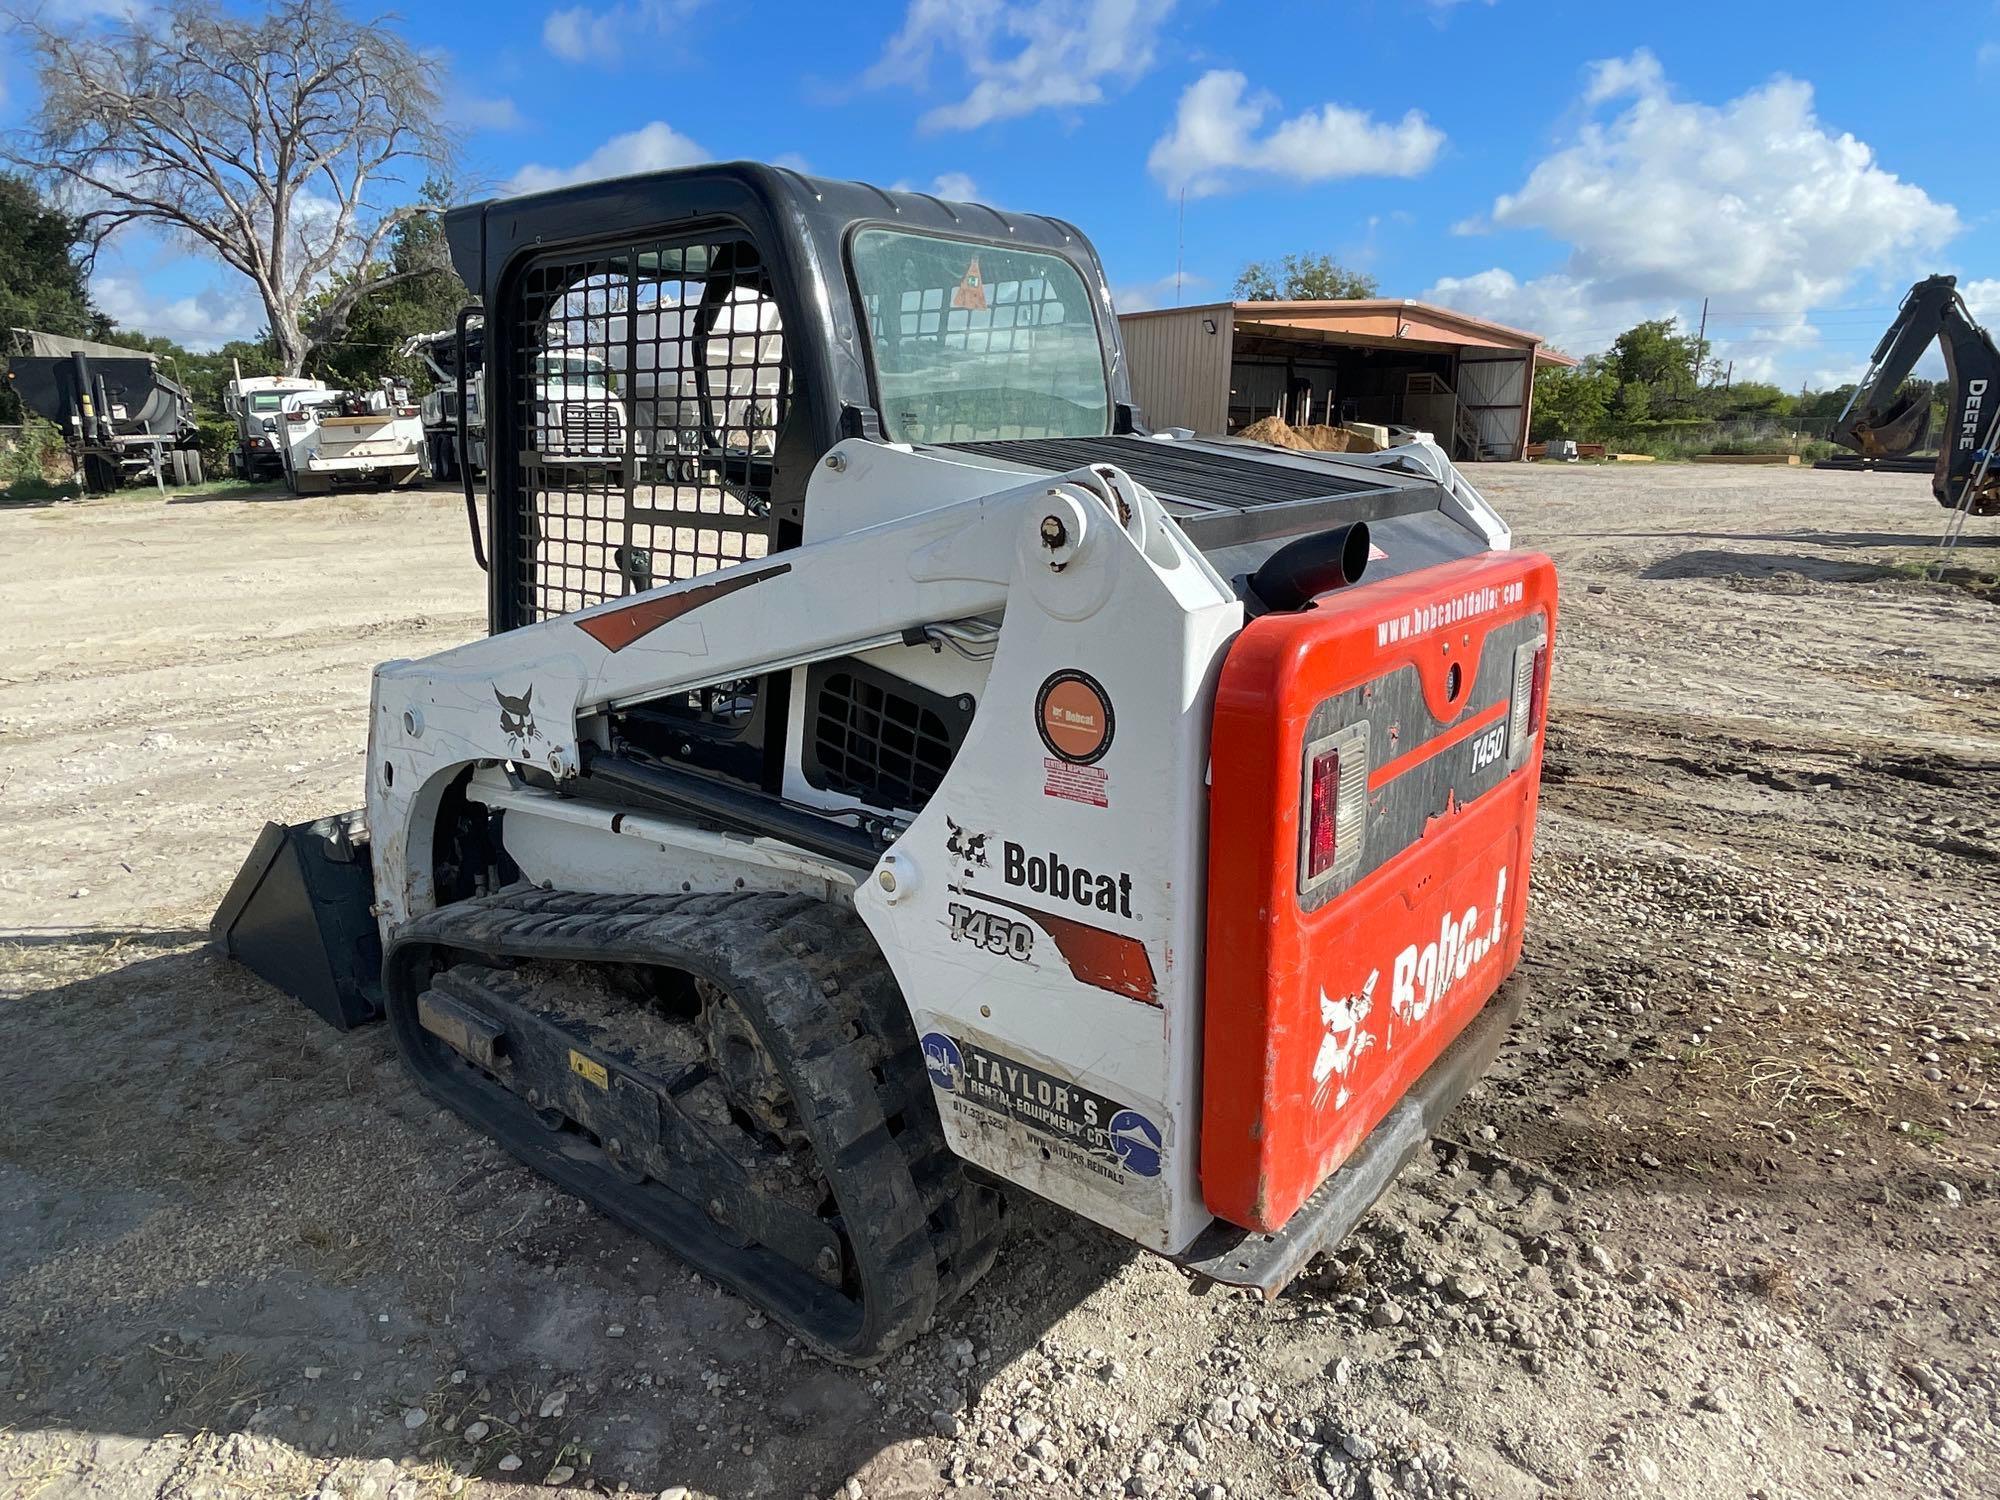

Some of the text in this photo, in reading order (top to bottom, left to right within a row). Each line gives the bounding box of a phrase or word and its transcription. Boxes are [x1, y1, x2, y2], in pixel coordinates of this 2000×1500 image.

[1958, 379, 1988, 450] DEERE
[1377, 581, 1523, 647] www.bobcatofdallacom
[1065, 710, 1094, 726] Bobcat
[1471, 725, 1505, 775] T450
[1003, 841, 1133, 918] Bobcat
[948, 902, 1034, 961] T450
[973, 1053, 1099, 1126] TAYLOR'S
